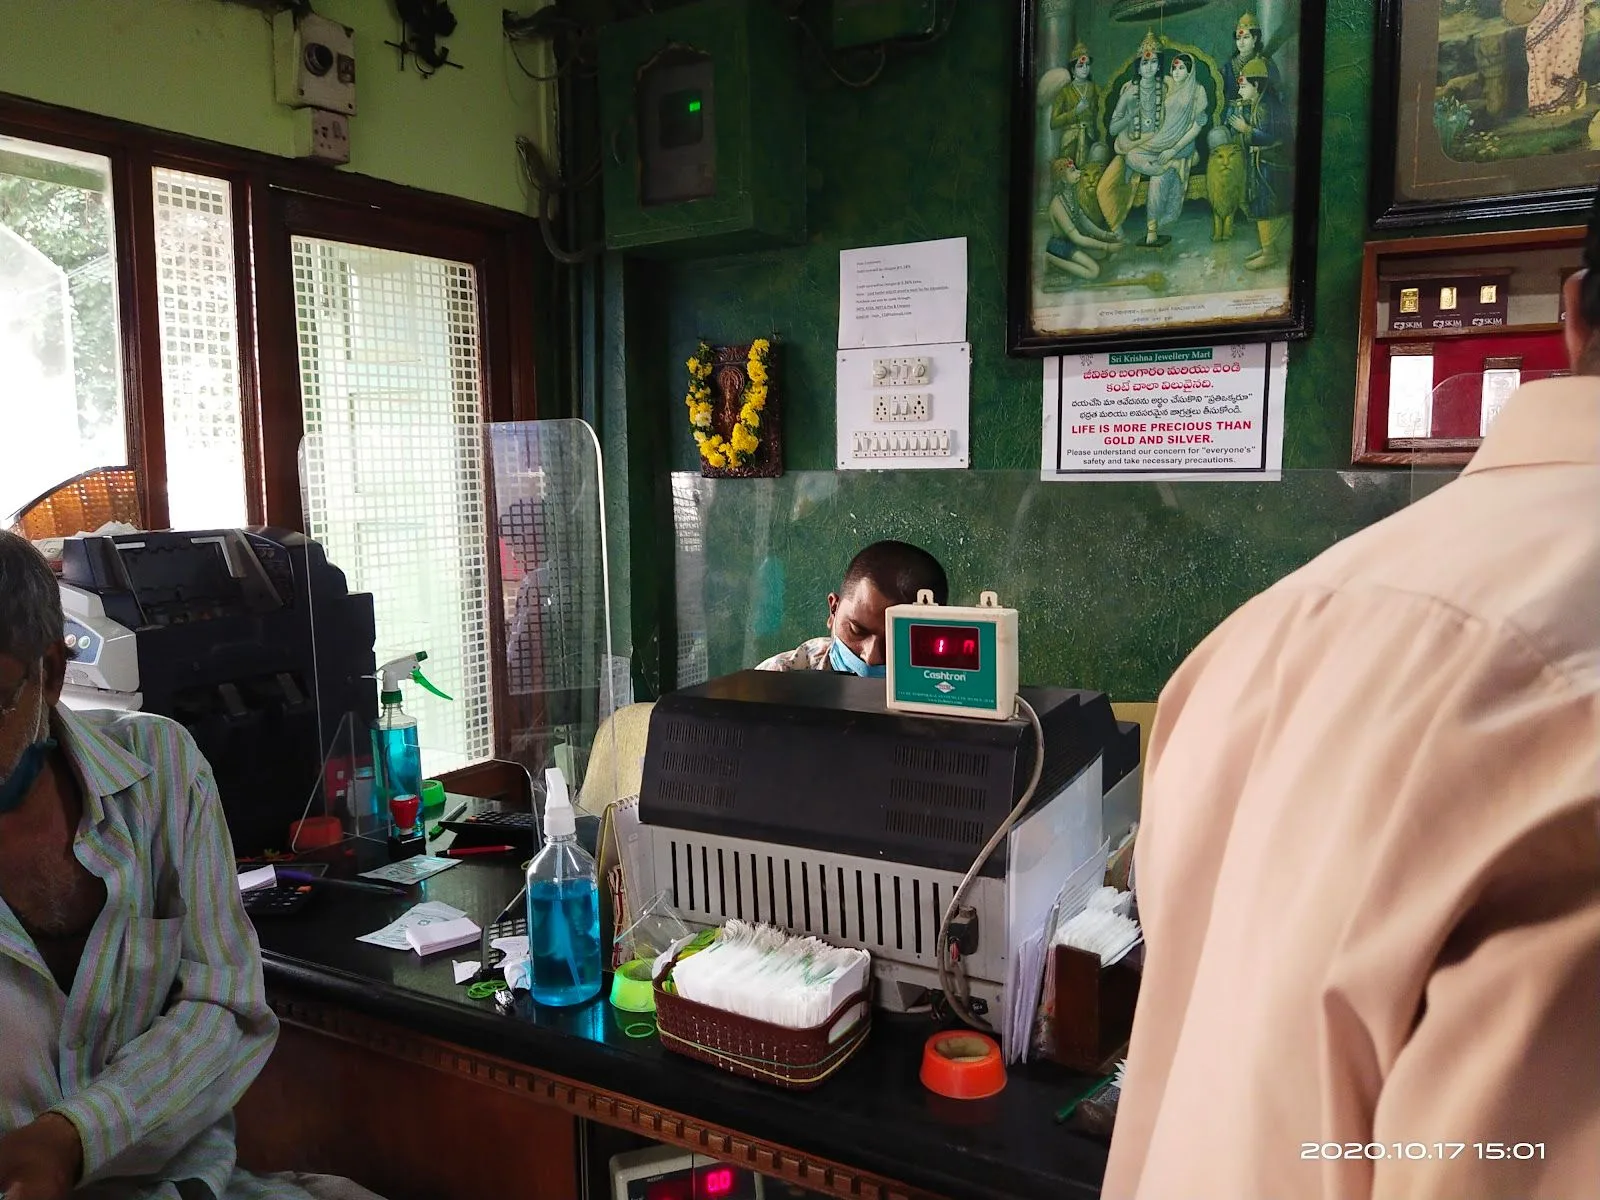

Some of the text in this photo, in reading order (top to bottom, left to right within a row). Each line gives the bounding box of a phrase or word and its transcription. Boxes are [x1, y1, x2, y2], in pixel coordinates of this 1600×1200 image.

[1111, 351, 1211, 363] Sri Krishna Jewellery Mart
[1118, 367, 1164, 378] బంగారం
[1167, 365, 1210, 376] మరియు
[1132, 382, 1159, 392] చాలా
[1072, 420, 1252, 434] LIFE IS MORE PRECIOUS THAN
[1104, 434, 1214, 445] GOLD AND SILVER.
[1093, 447, 1136, 456] understand
[1083, 457, 1106, 466] safety
[1142, 458, 1182, 466] necessary
[1185, 456, 1236, 465] precautions.
[923, 669, 966, 681] Cashtron
